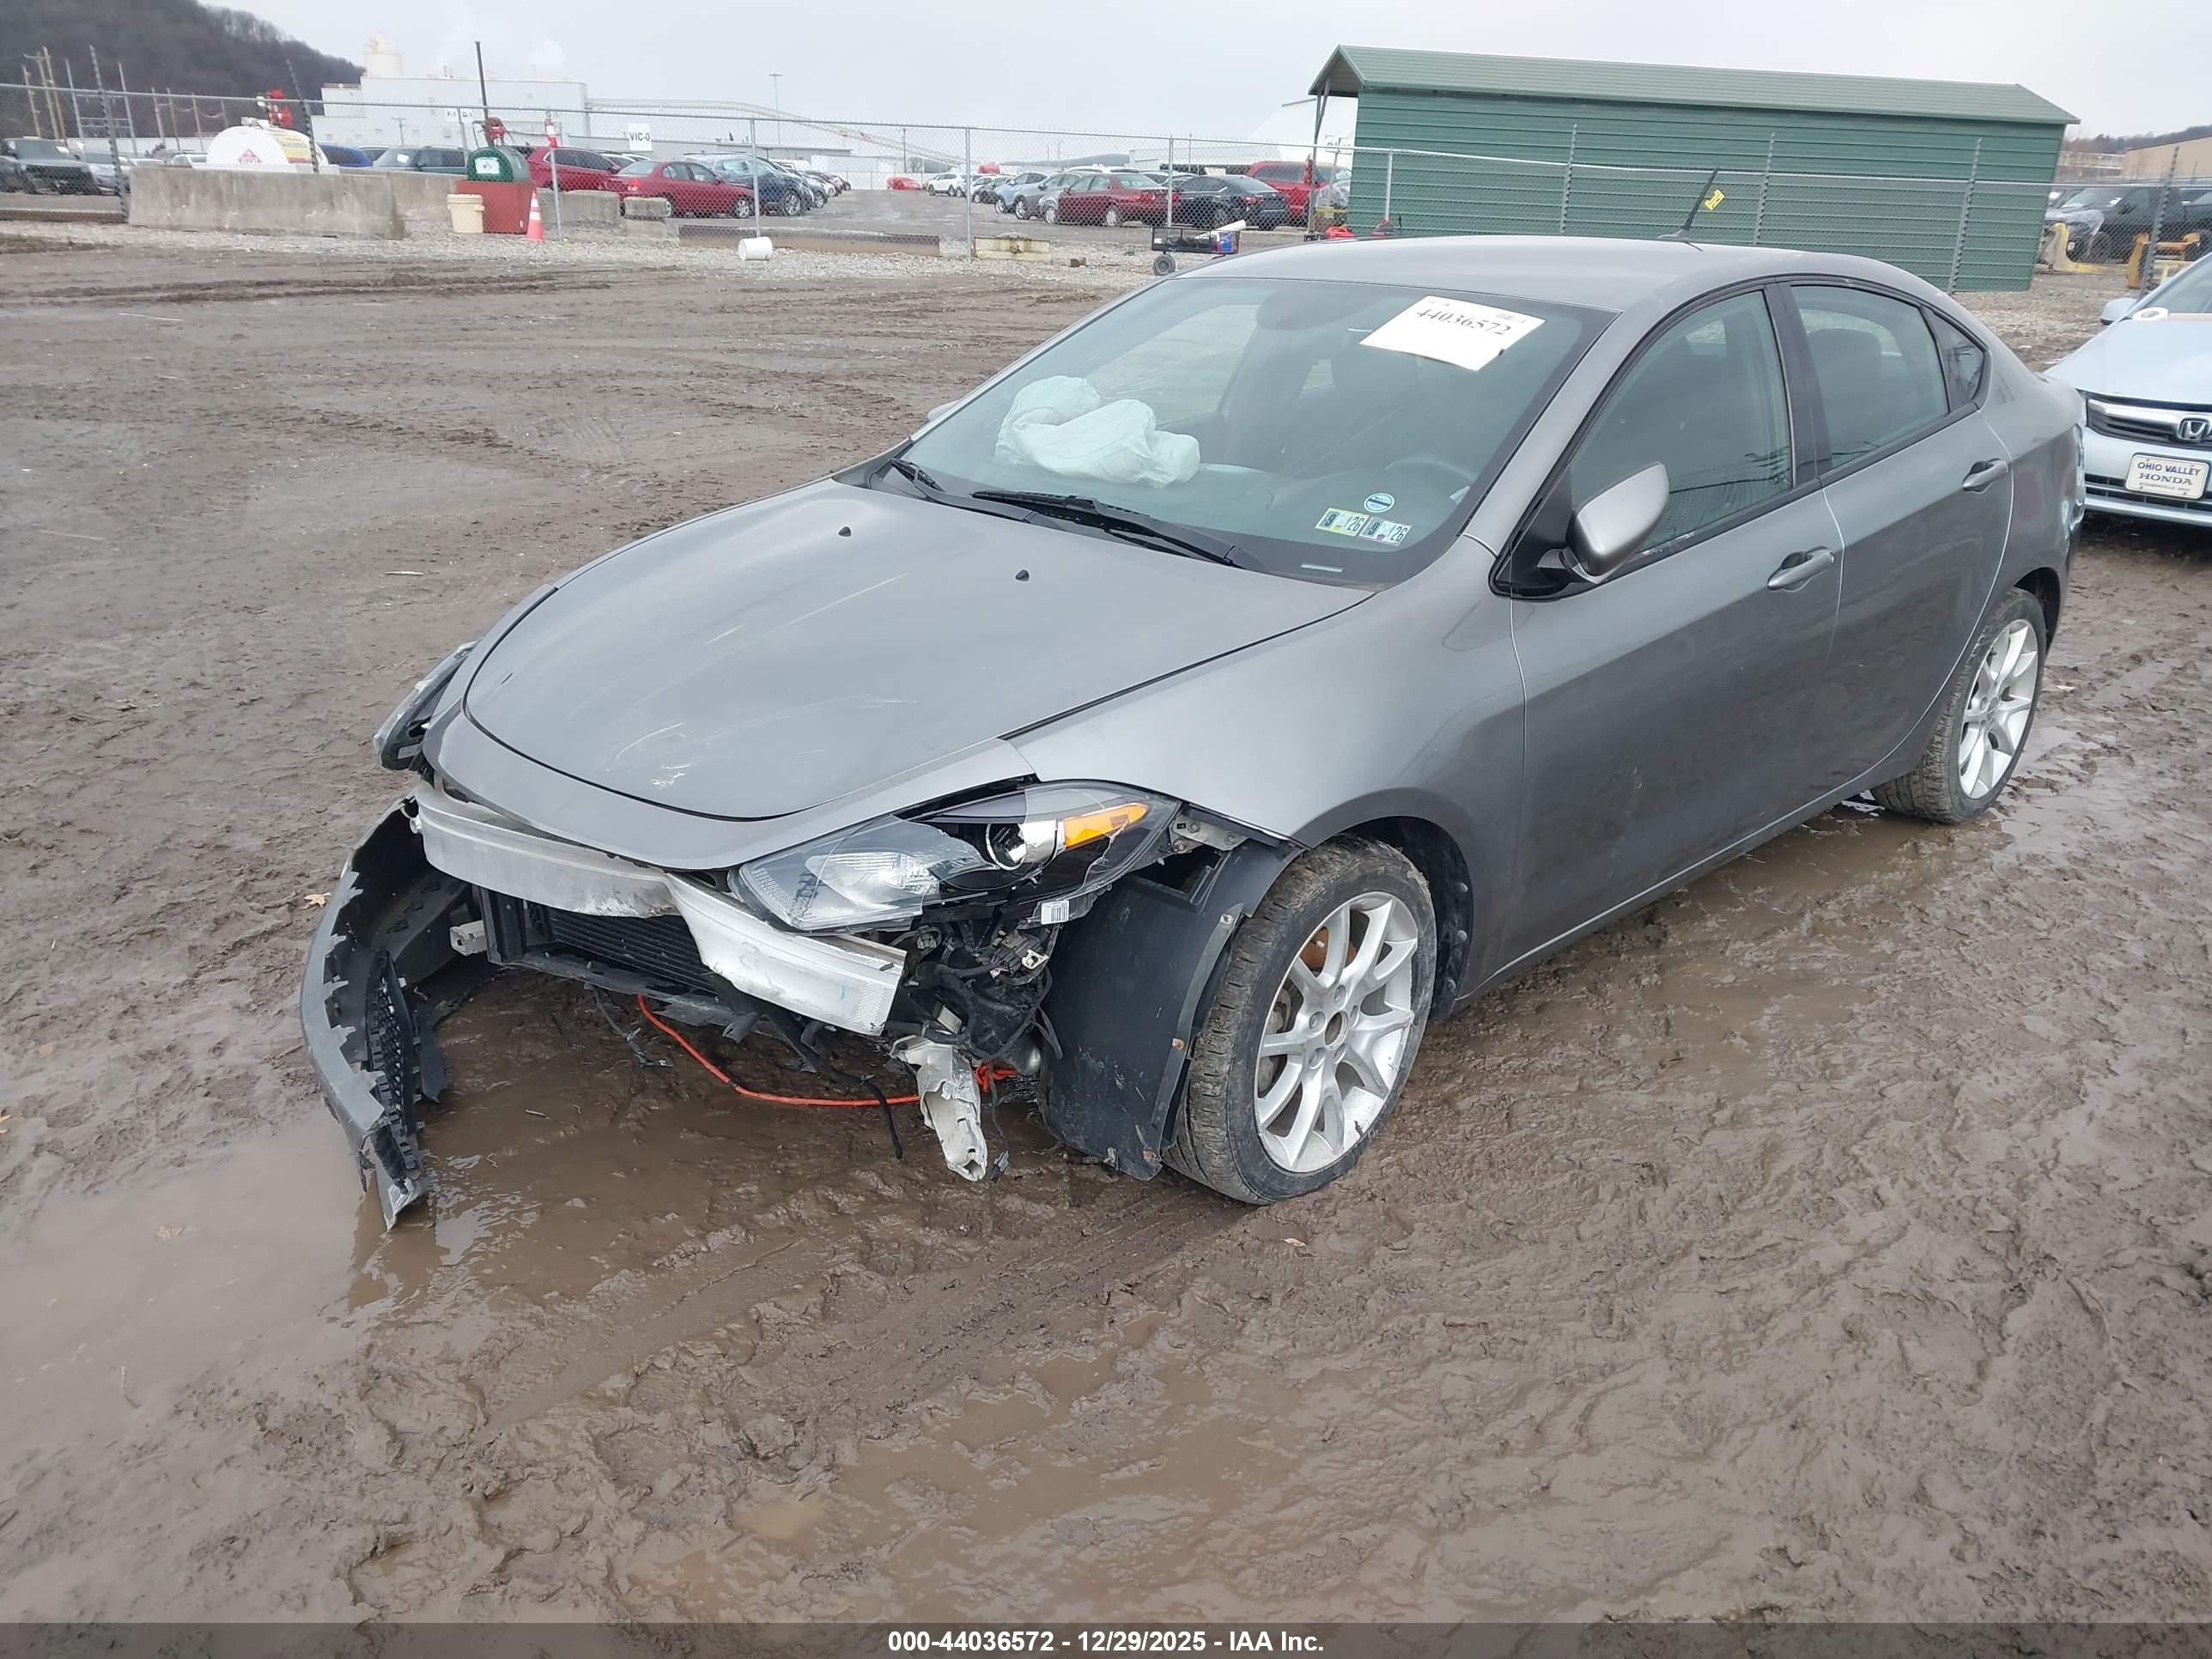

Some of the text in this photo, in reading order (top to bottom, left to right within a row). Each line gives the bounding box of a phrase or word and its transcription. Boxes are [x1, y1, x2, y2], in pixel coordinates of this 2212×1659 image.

[1416, 308, 1511, 335] 44036572
[2137, 461, 2202, 476] OHIO VALLEY
[2138, 472, 2193, 486] HONDA
